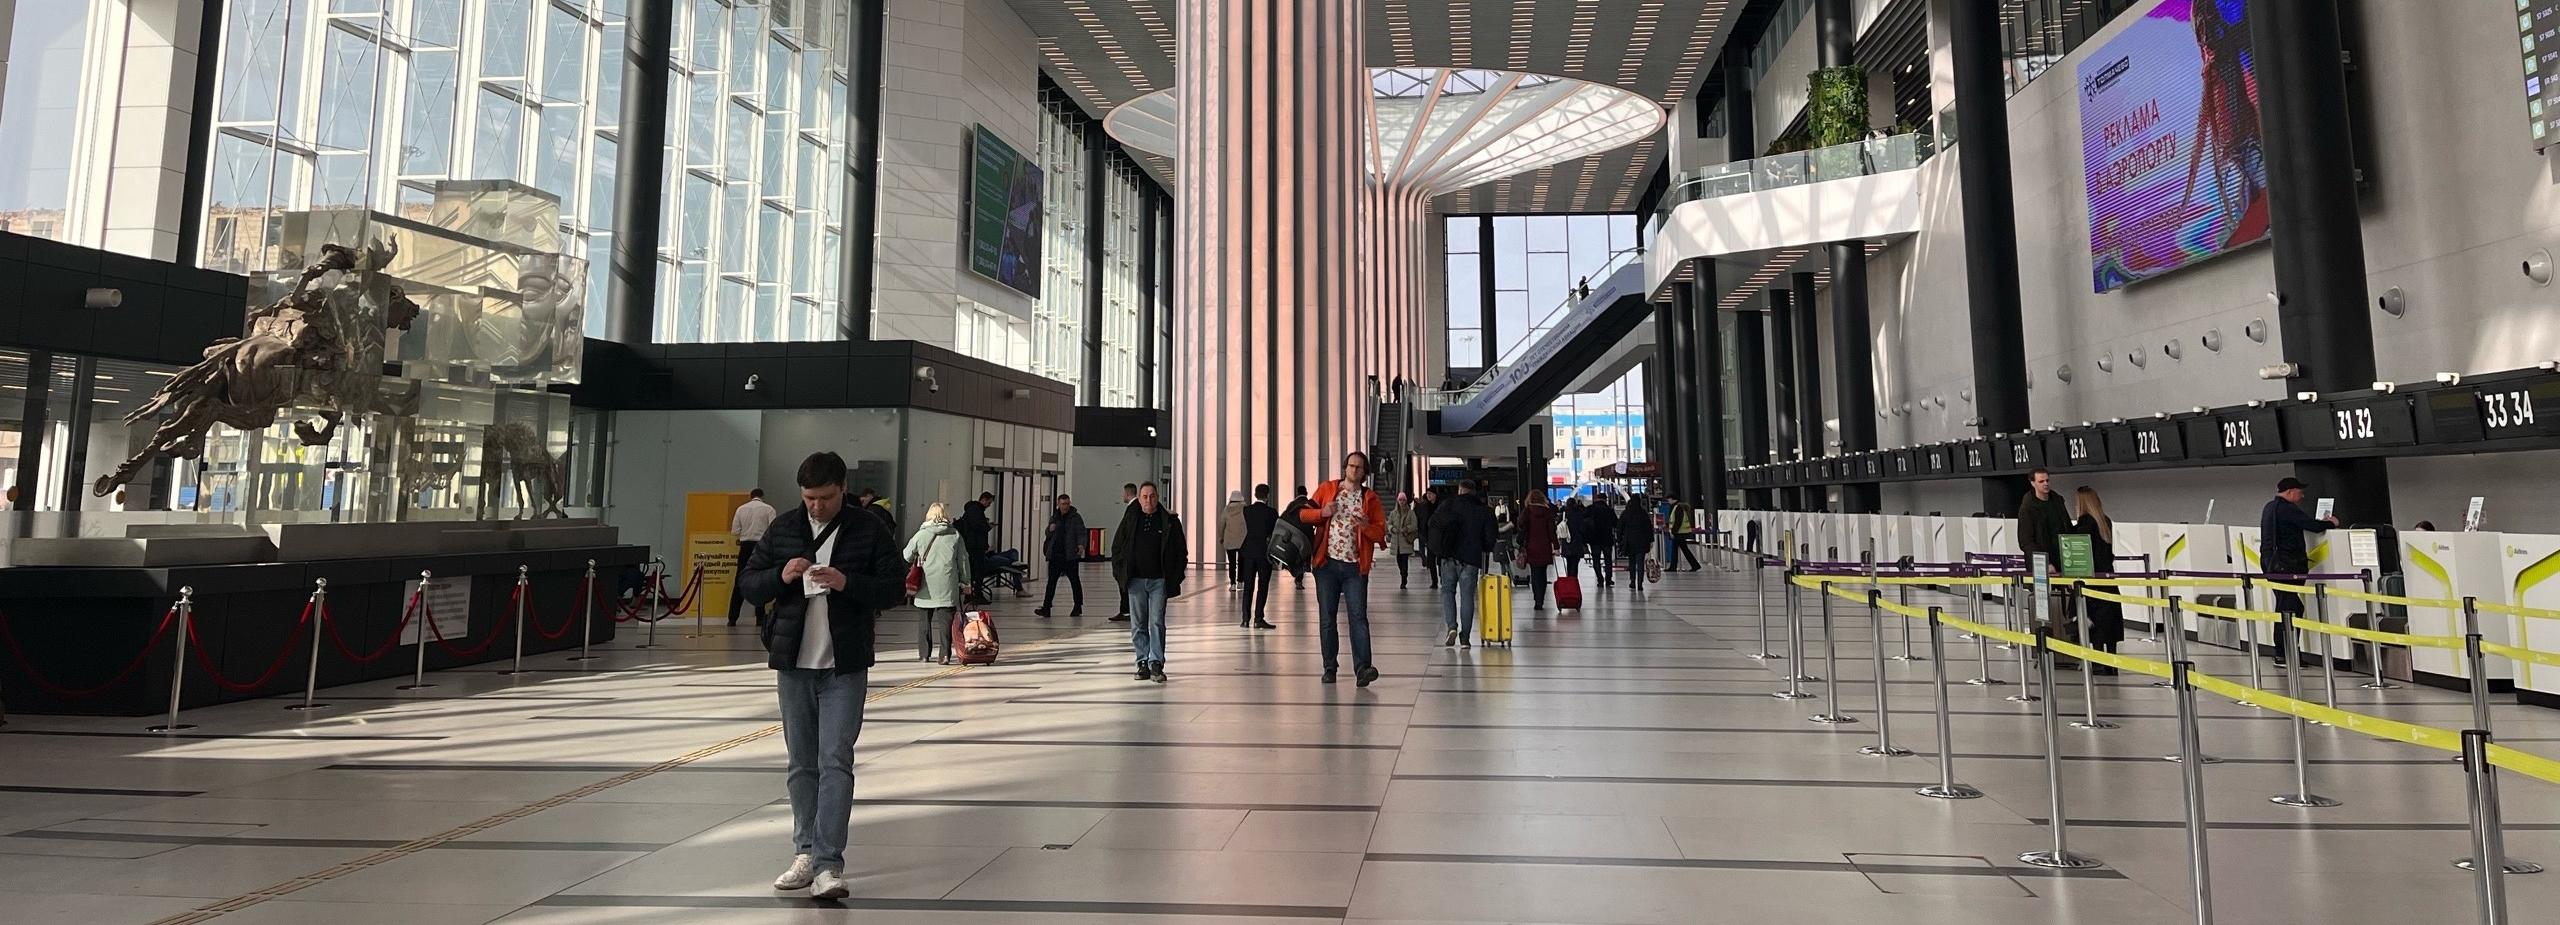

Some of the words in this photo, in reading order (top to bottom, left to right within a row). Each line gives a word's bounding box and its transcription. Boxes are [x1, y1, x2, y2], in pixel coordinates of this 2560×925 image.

[2104, 98, 2160, 151] РЕКЛАМА
[2106, 130, 2177, 190] АЭРОПОРТУ
[2337, 410, 2353, 440] 31
[2355, 407, 2374, 439] 32
[2484, 393, 2508, 428] 33
[2510, 390, 2534, 426] 34
[2069, 438, 2079, 458] 25
[2137, 431, 2147, 453] 27
[2224, 421, 2237, 447] 29
